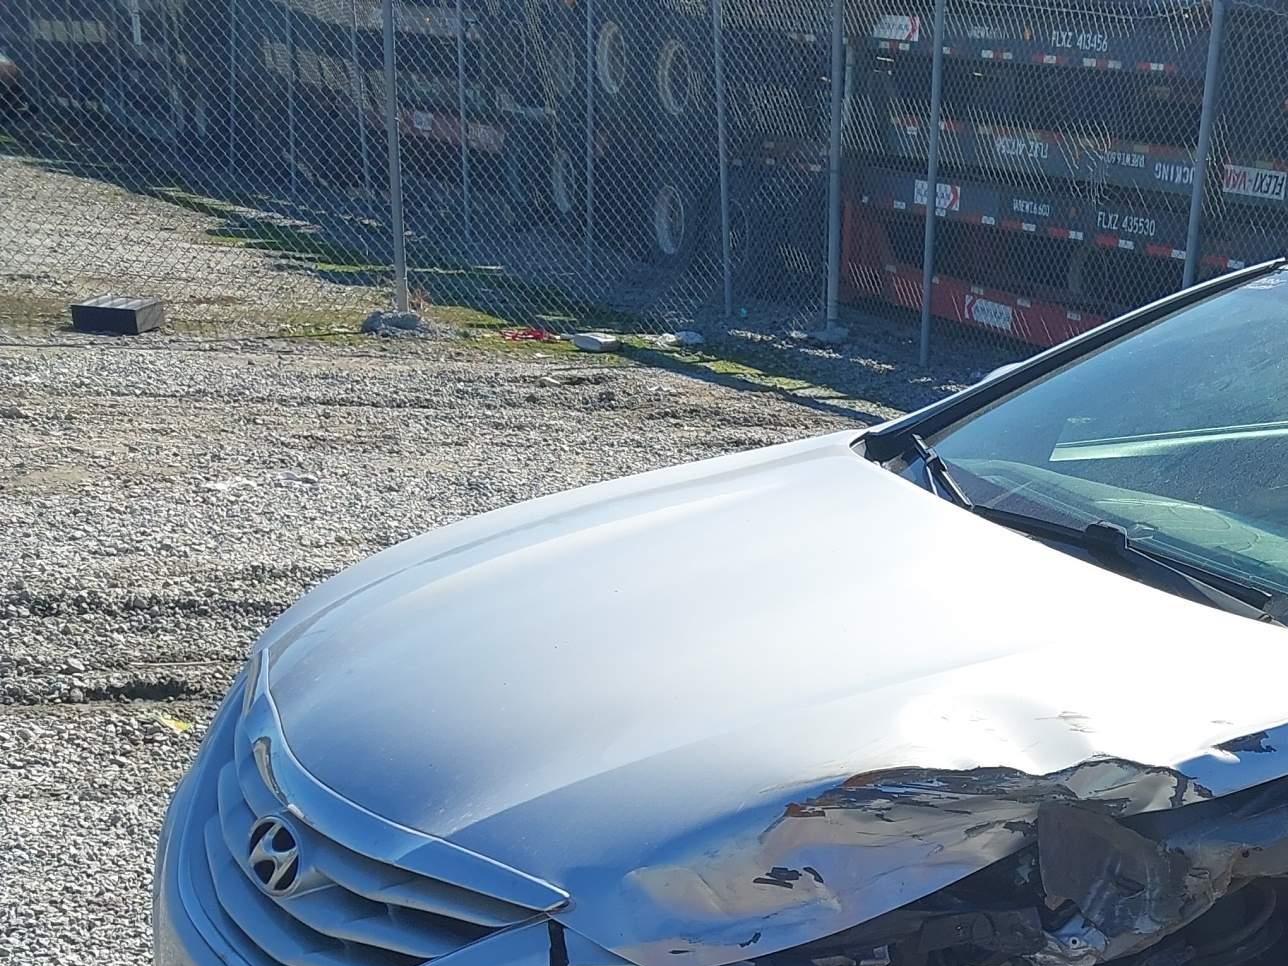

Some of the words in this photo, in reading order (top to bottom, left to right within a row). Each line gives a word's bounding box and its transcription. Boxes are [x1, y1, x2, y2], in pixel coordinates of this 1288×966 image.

[1051, 31, 1072, 48] FLXZ
[1223, 166, 1286, 200] FLEXI-VAN
[1097, 211, 1119, 230] FLXZ
[1122, 215, 1156, 237] 435530
